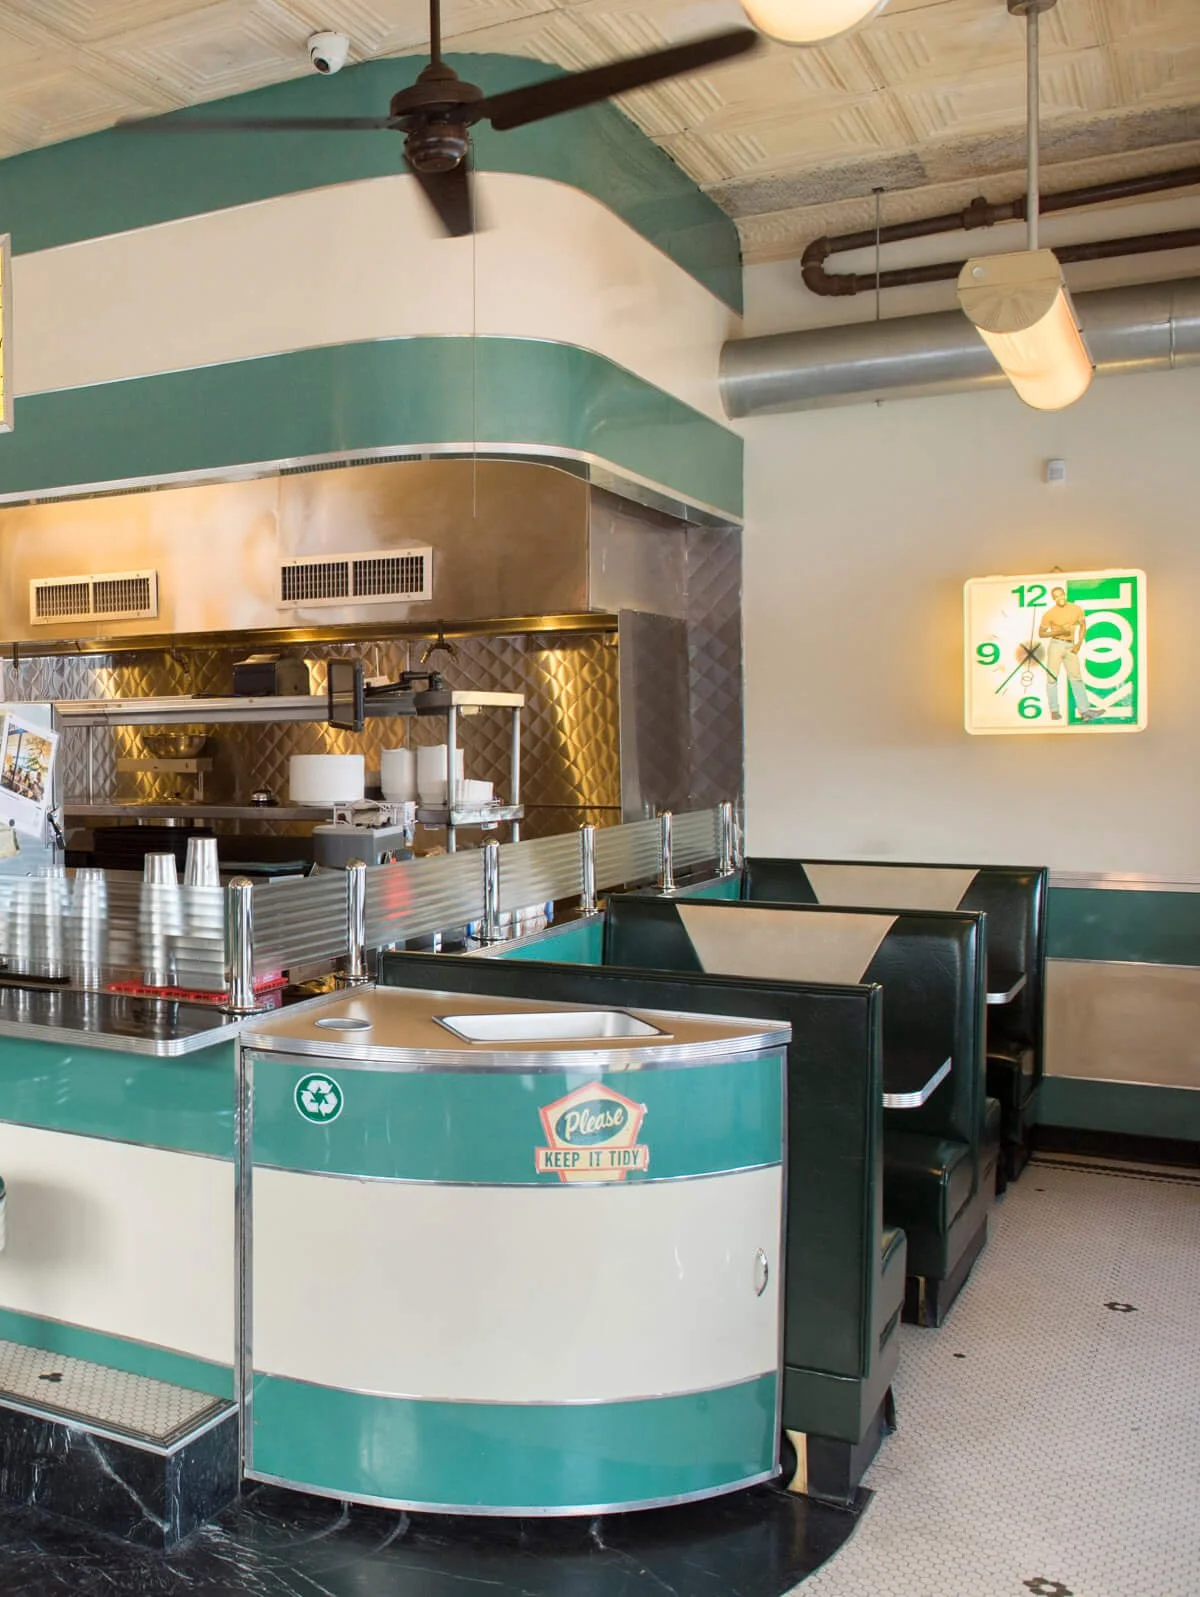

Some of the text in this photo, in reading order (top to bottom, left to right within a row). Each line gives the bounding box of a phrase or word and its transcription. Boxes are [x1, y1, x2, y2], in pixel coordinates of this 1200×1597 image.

[1012, 585, 1047, 608] 12
[976, 642, 1000, 665] 9
[1074, 582, 1133, 718] KOOL
[1018, 696, 1042, 719] 6
[564, 1108, 624, 1142] Please
[544, 1150, 640, 1168] KEEP IT TIDY
